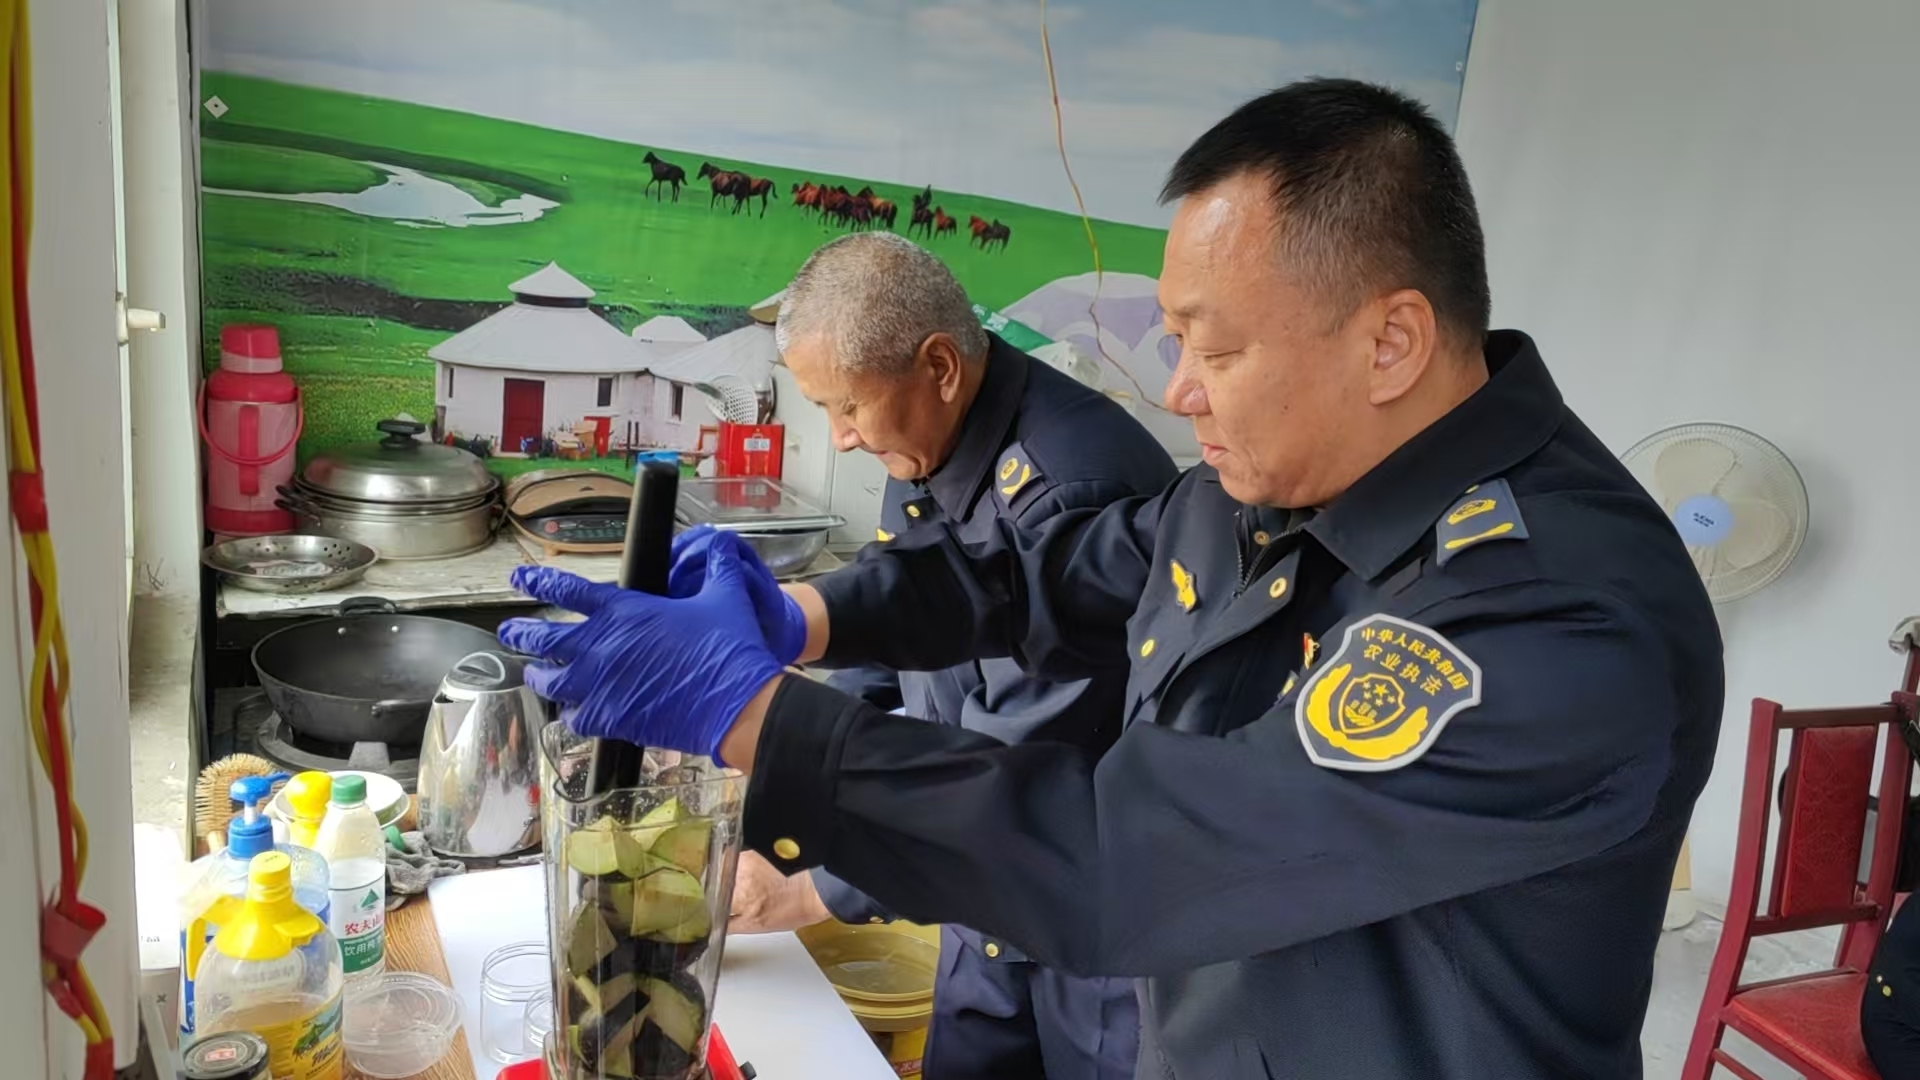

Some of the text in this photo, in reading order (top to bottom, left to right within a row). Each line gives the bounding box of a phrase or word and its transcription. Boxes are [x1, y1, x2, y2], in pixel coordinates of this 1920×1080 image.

[1361, 627, 1469, 690] 中华人民共和国
[1363, 643, 1443, 696] 农业执法
